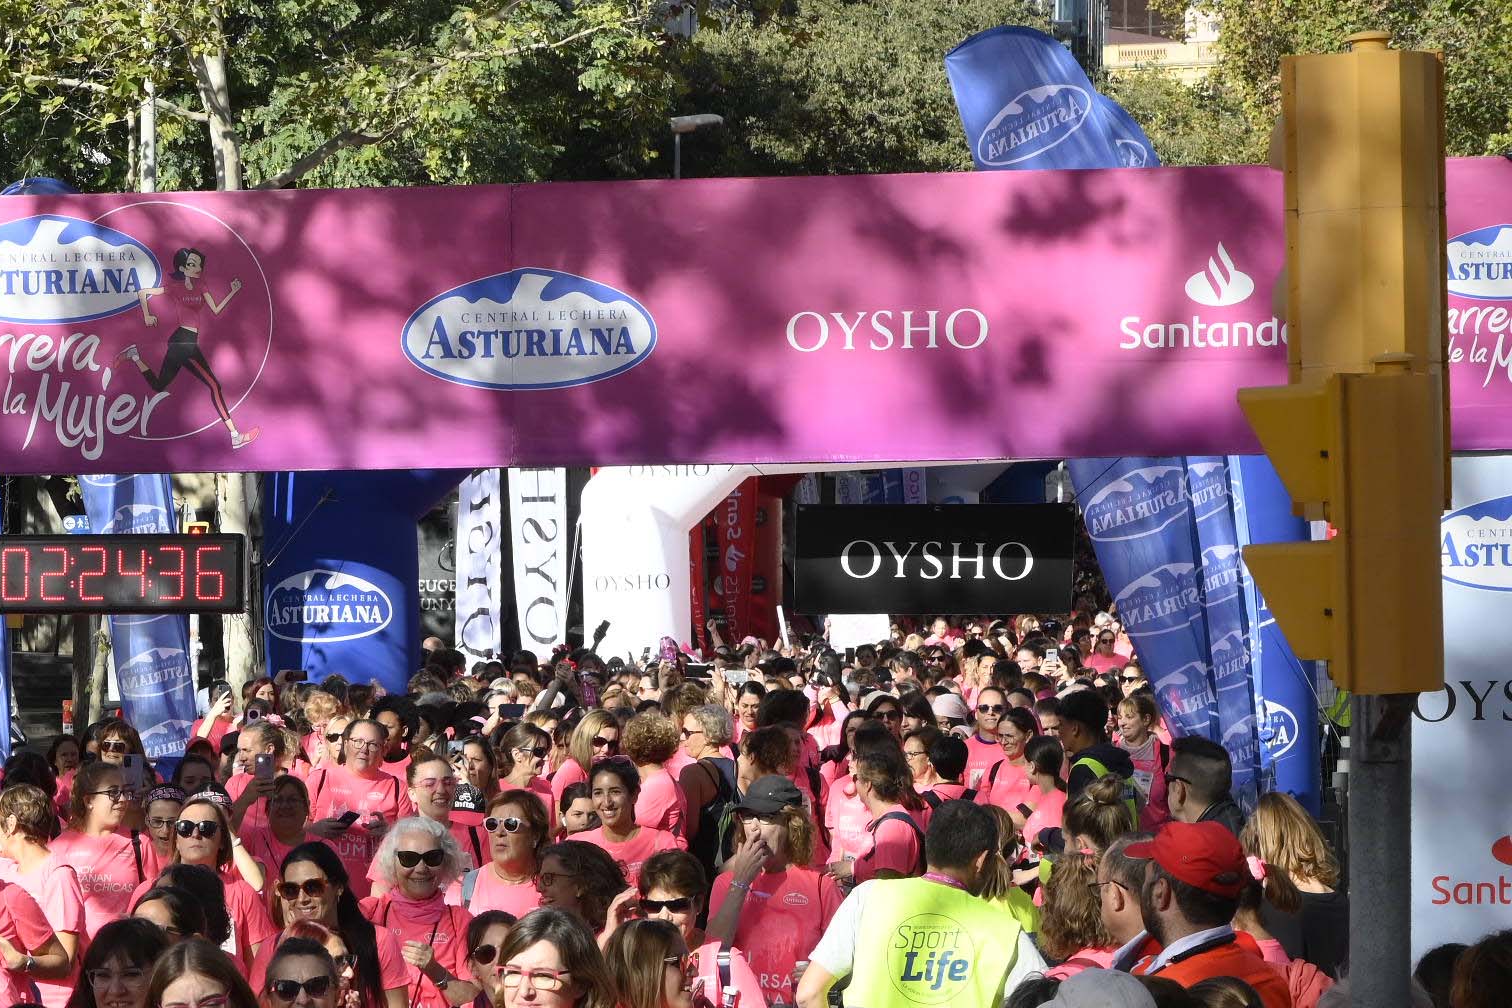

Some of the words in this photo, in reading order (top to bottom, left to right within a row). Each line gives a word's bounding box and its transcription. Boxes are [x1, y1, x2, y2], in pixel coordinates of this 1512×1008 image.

[64, 250, 137, 262] LECHERA
[461, 311, 539, 324] CENTRAL
[548, 308, 628, 321] LECHERA
[785, 308, 989, 352] OYSHO
[421, 315, 637, 360] ASTURIANA
[1469, 335, 1488, 363] la
[1, 373, 27, 415] la
[21, 365, 171, 461] Mujer
[0, 546, 224, 601] 02:24:36
[840, 540, 1035, 580] OYSHO
[594, 573, 671, 592] OYSHO
[269, 598, 384, 628] ASTURIANA
[329, 594, 379, 603] LECHERA
[94, 882, 135, 893] CHICAS
[894, 924, 961, 953] Sport
[900, 950, 969, 991] Life
